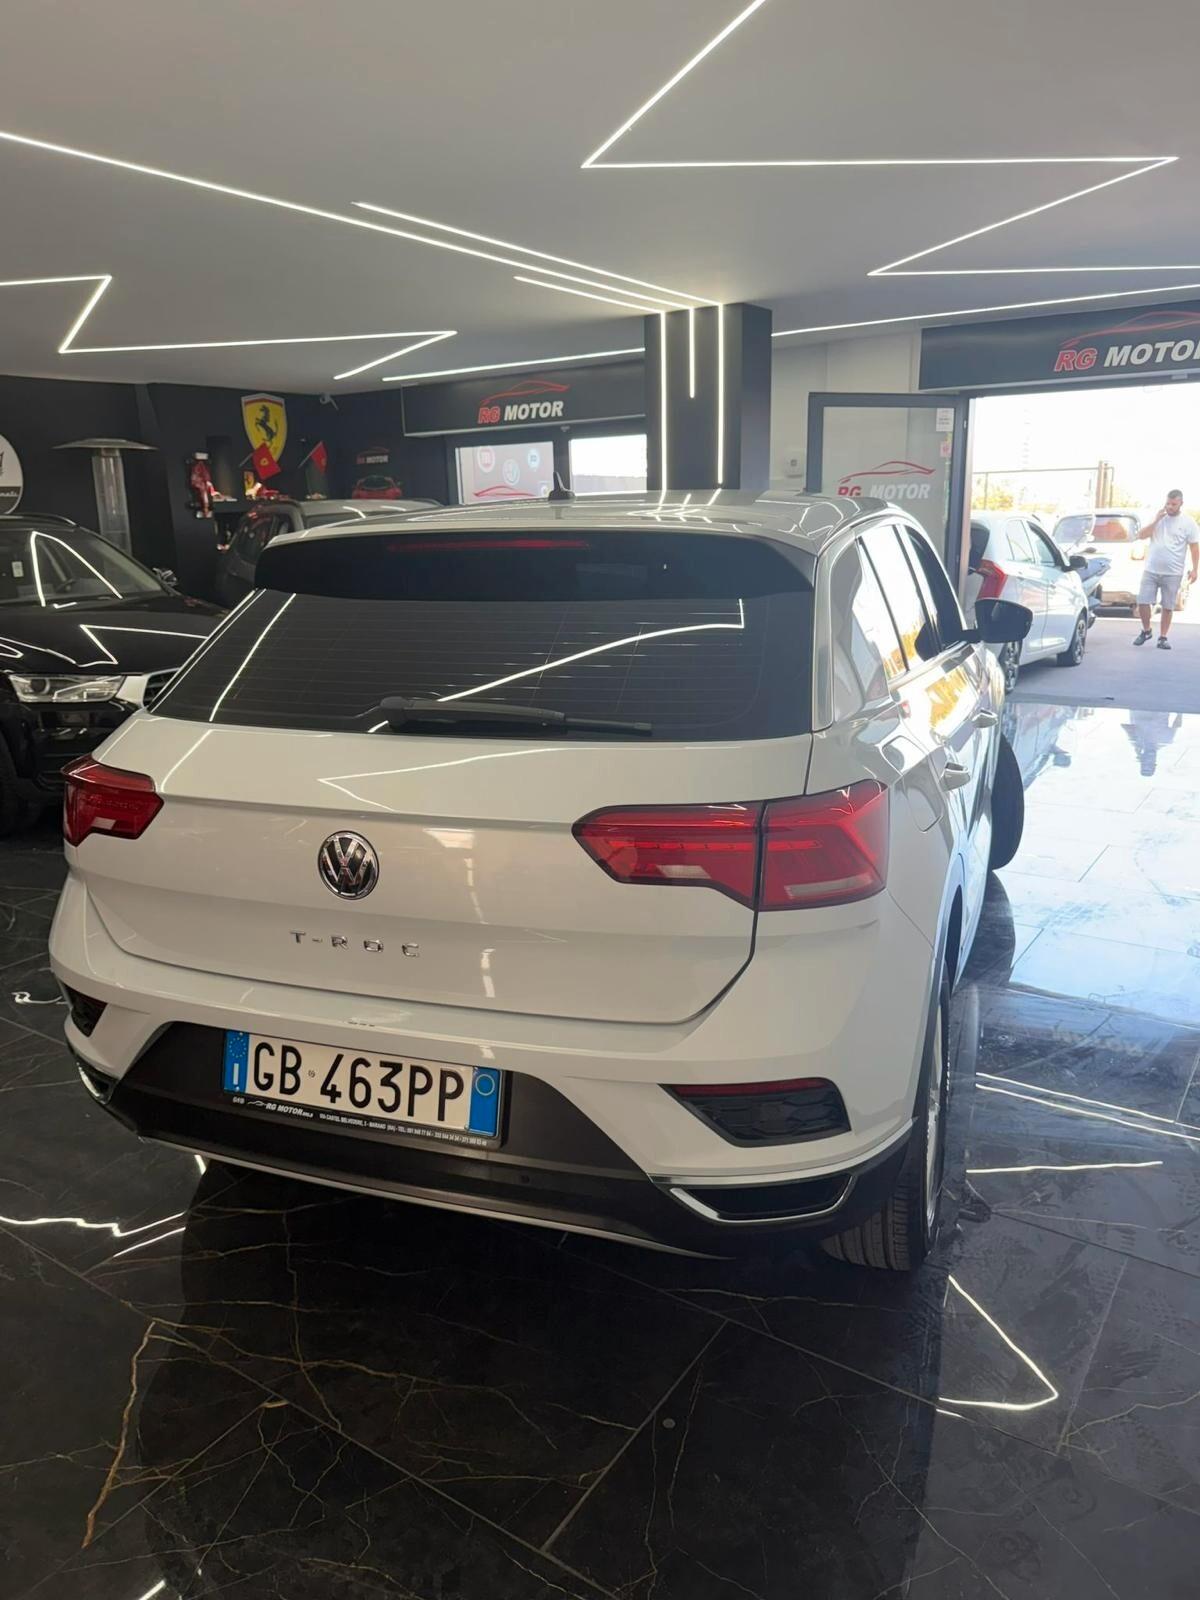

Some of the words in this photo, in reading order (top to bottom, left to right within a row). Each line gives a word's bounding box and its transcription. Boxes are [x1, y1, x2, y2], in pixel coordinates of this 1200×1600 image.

[1053, 347, 1098, 372] RG
[477, 405, 500, 424] RG
[504, 401, 564, 421] MOTOR
[869, 484, 930, 500] MOTOR
[289, 929, 419, 957] T-ROC
[253, 1041, 302, 1096] GB
[320, 1053, 465, 1122] 463PP
[265, 1102, 277, 1111] RG
